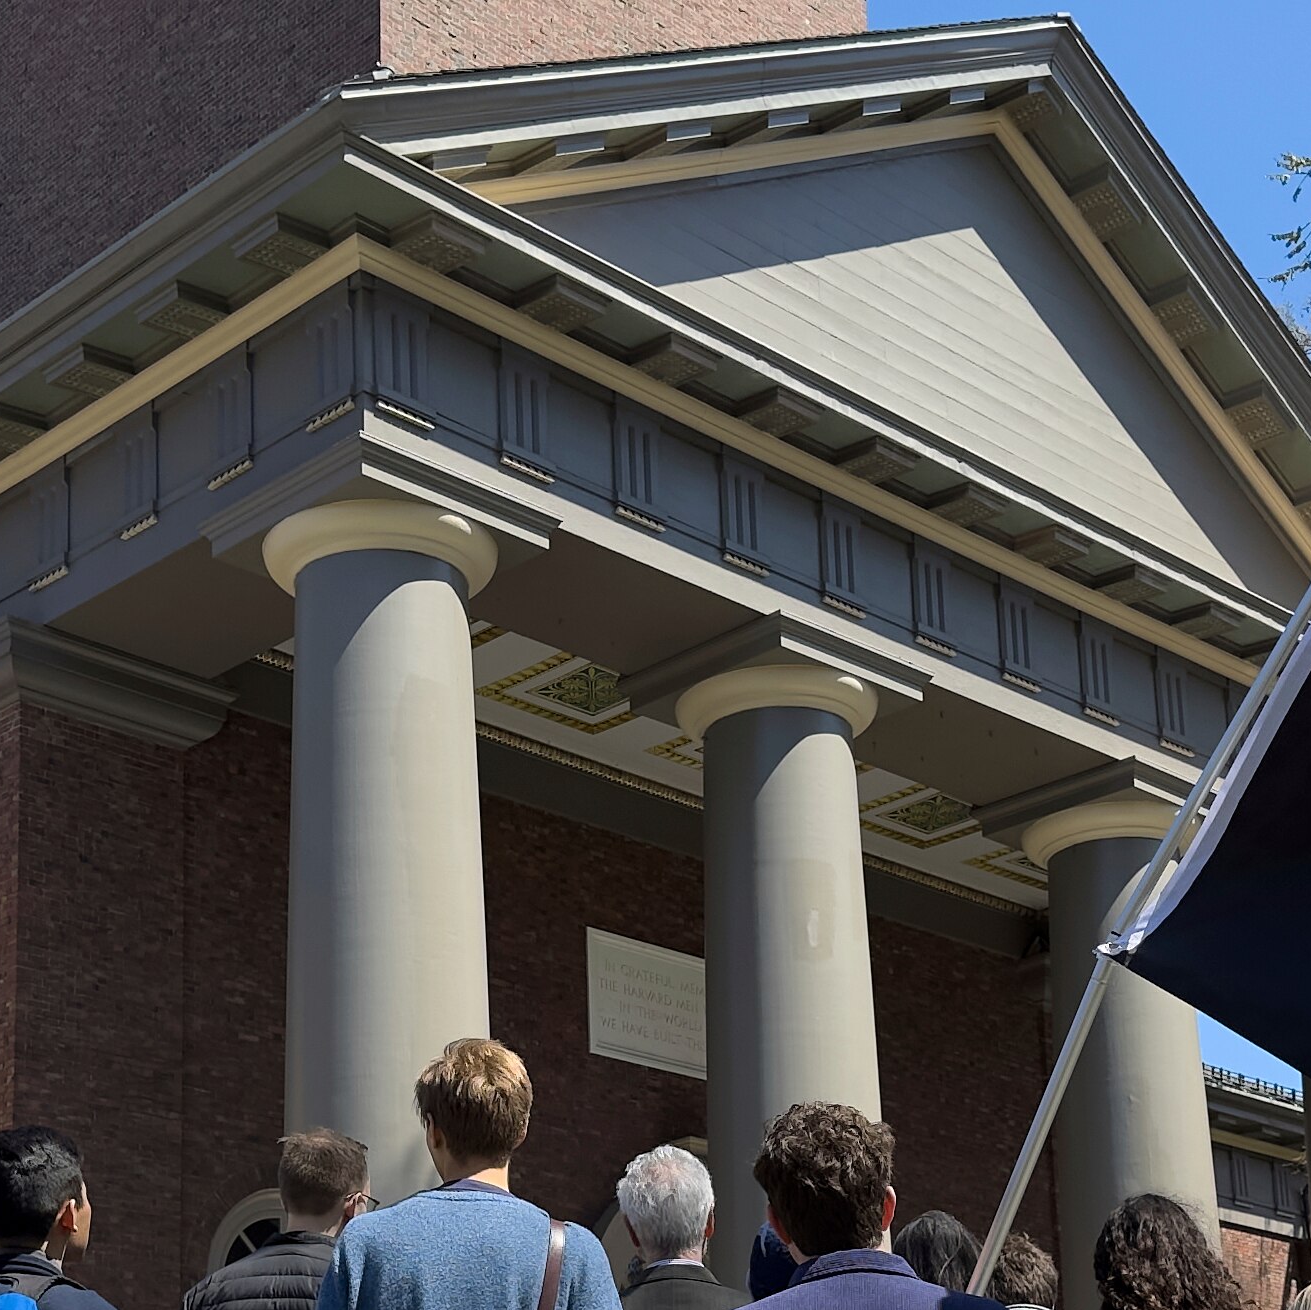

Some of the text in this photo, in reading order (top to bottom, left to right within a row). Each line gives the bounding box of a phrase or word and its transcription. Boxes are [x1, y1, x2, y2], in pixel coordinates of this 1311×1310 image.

[604, 958, 705, 996] IN GRATEFUL MEM
[598, 977, 699, 1014] THE HARVARD MEN
[619, 1000, 631, 1014] IN
[635, 1005, 657, 1021] THE
[600, 1015, 617, 1031] WE
[621, 1020, 649, 1038] HAVE
